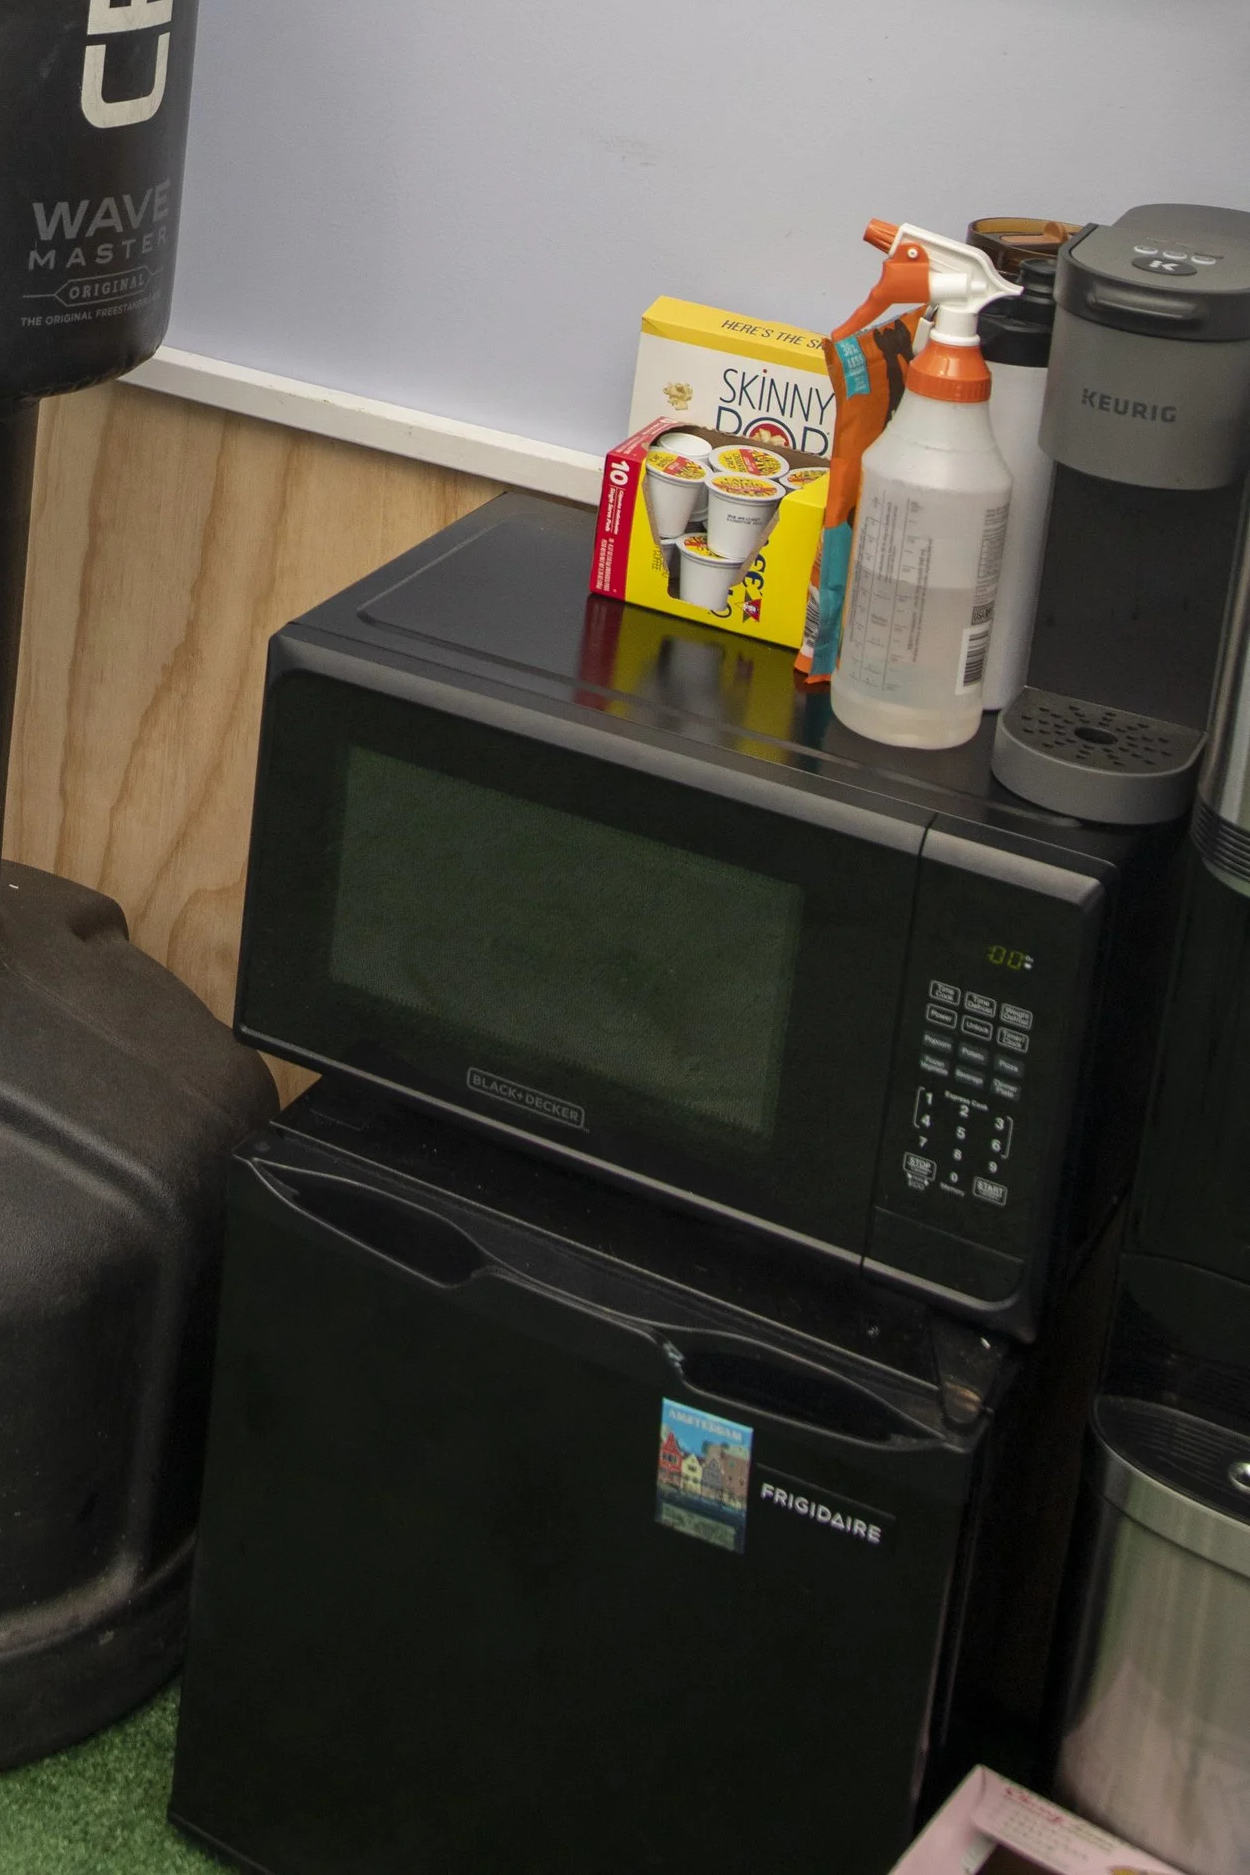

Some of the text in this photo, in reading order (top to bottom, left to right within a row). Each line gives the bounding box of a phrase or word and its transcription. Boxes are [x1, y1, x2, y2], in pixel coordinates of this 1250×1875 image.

[32, 178, 170, 241] WAVE
[28, 226, 167, 270] MASTER
[68, 273, 145, 300] ORIGINAL
[21, 316, 43, 326] THE
[45, 309, 93, 325] ORIGINAL
[721, 319, 774, 338] HERE'S
[776, 331, 806, 346] THE
[719, 368, 835, 425] SKINNY
[1081, 387, 1177, 423] KEURIG
[609, 460, 630, 486] 10
[473, 1074, 579, 1122] BLACK+DECKER
[926, 1092, 933, 1105] 1
[959, 1104, 969, 1118] 2
[921, 1114, 931, 1128] 4
[994, 1117, 1004, 1131] 3
[956, 1126, 966, 1140] 5
[919, 1135, 928, 1148] 7
[991, 1138, 1001, 1152] 6
[953, 1148, 962, 1161] 8
[909, 1156, 932, 1169] STOP
[988, 1161, 997, 1173] 9
[950, 1172, 958, 1183] 0
[977, 1180, 1004, 1193] START
[668, 1407, 743, 1442] AMSTERDAM
[760, 1482, 882, 1544] FRIGIDAIRE
